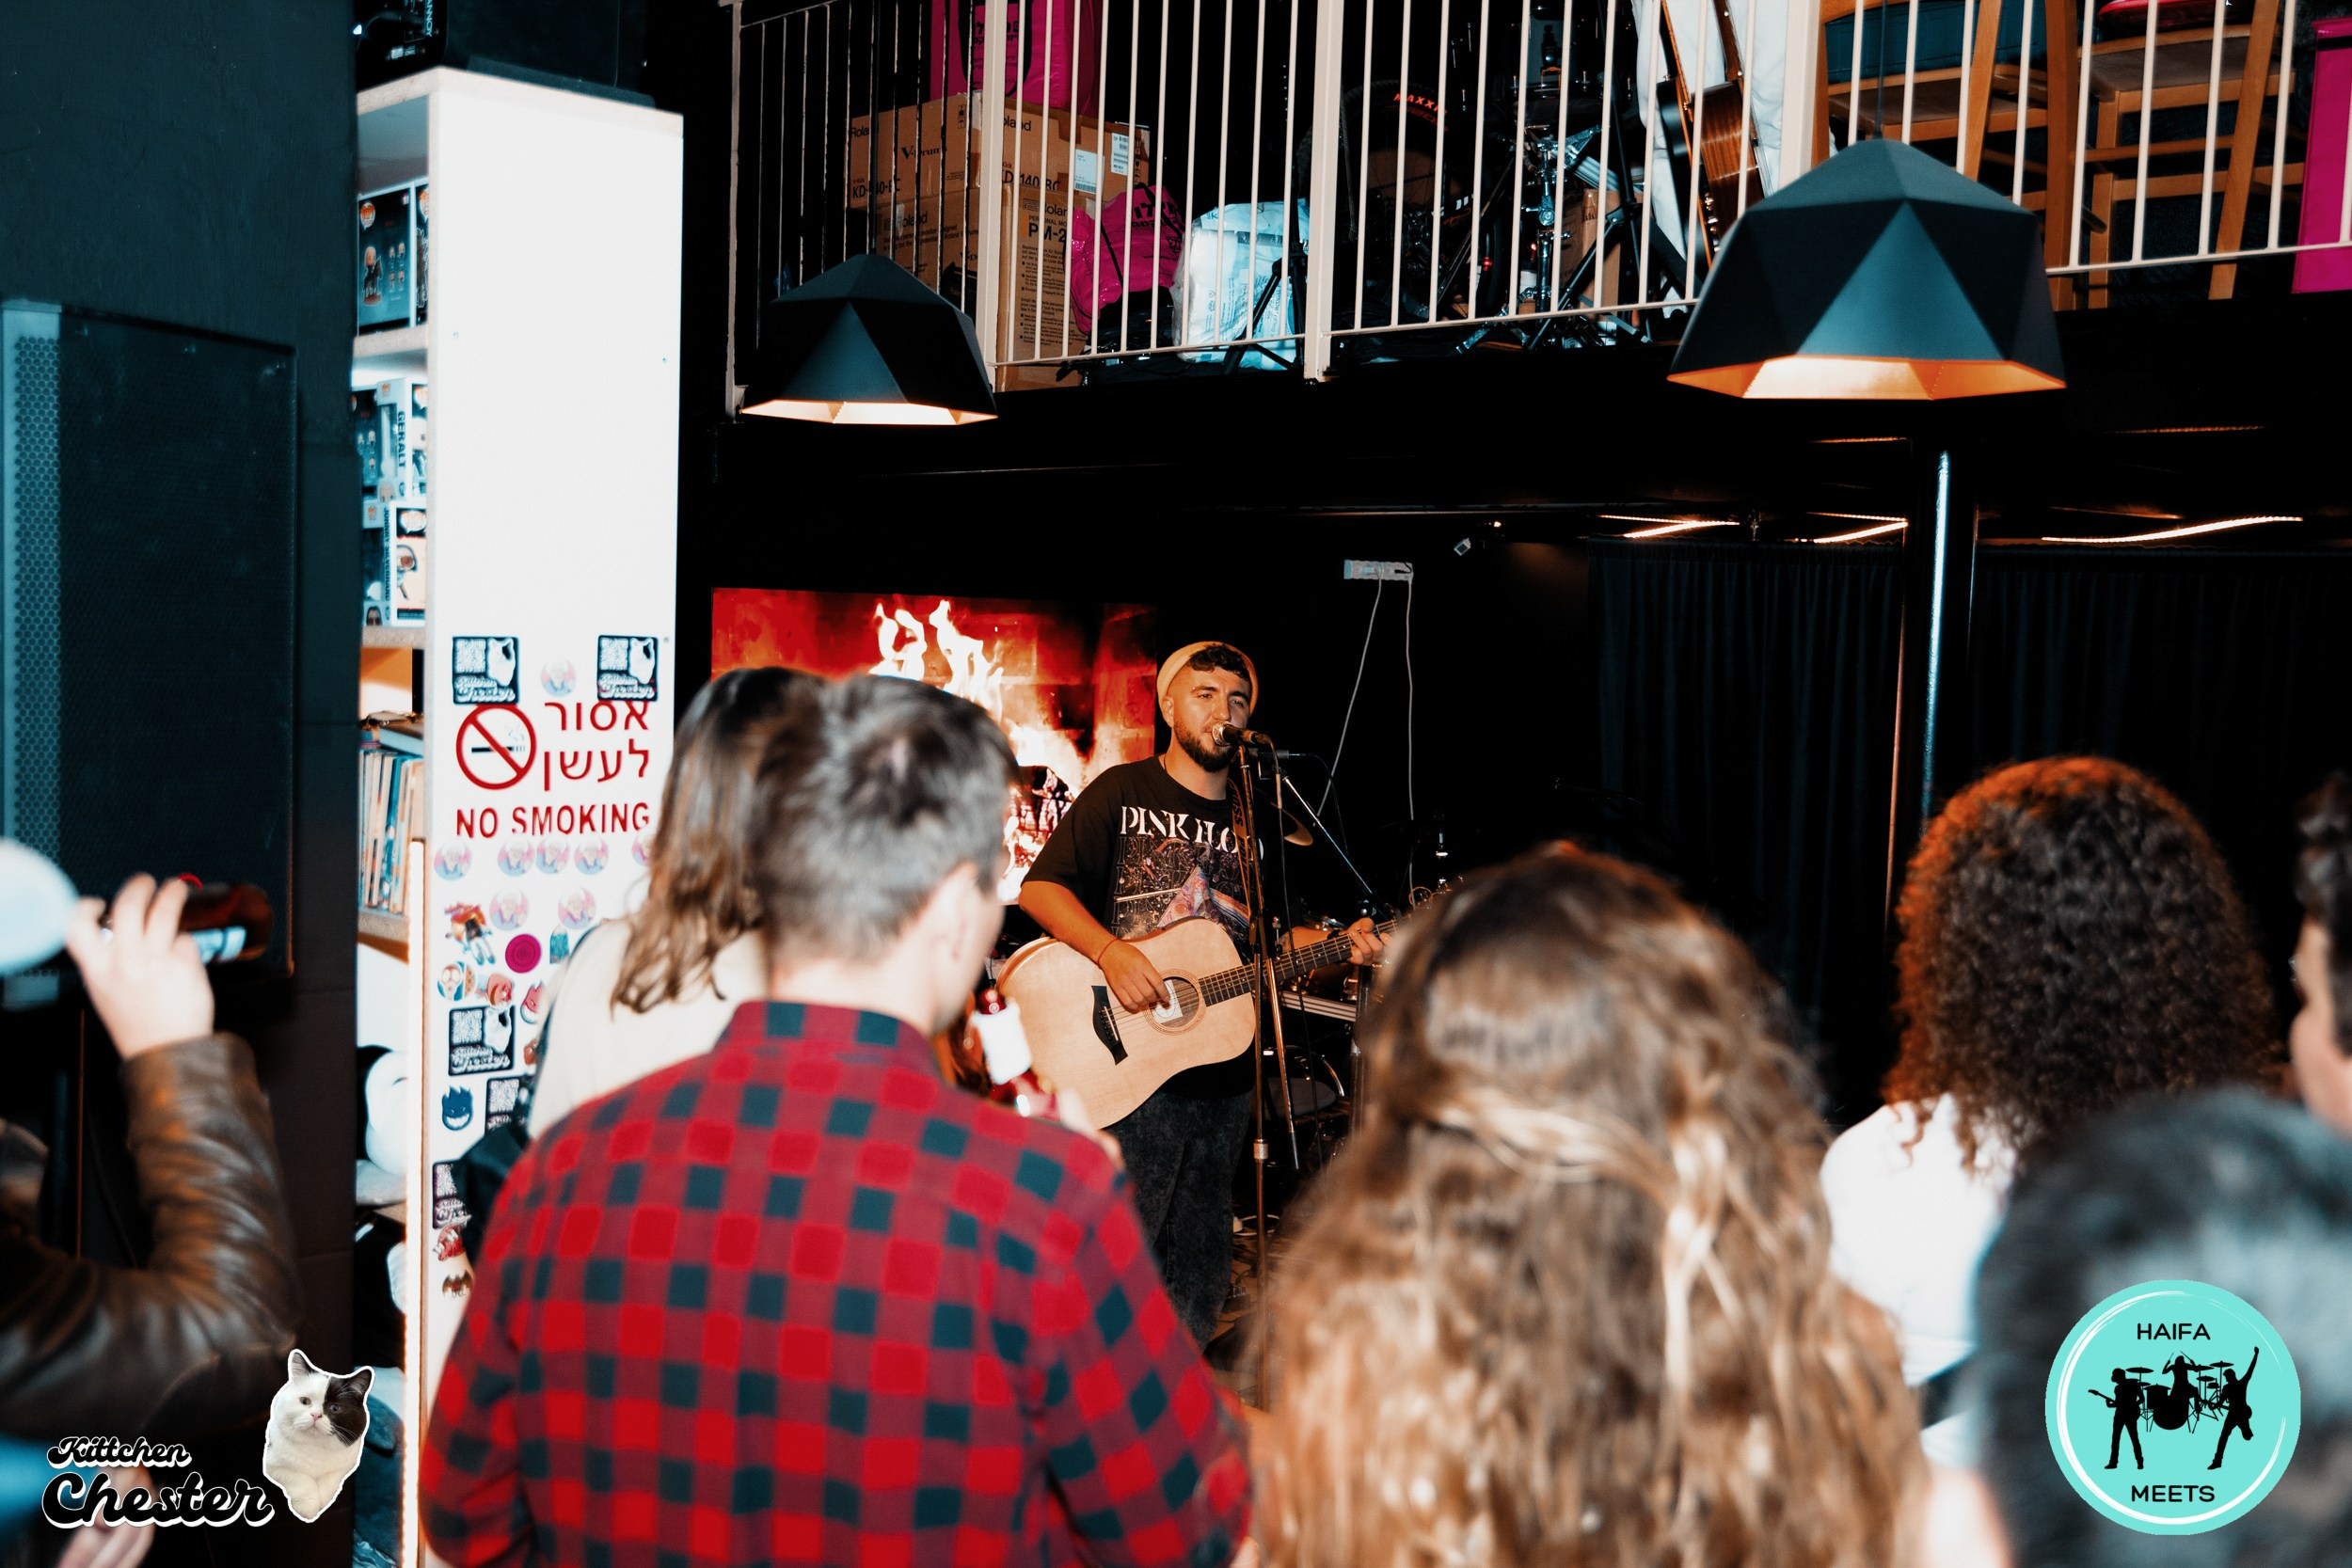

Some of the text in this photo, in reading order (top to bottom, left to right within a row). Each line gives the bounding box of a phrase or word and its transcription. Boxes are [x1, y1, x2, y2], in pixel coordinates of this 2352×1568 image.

[397, 411, 406, 468] GERALT
[544, 701, 650, 732] אסור
[543, 738, 650, 792] לעשן
[456, 801, 650, 838] NO SMOKING
[1120, 805, 1191, 841] PINK
